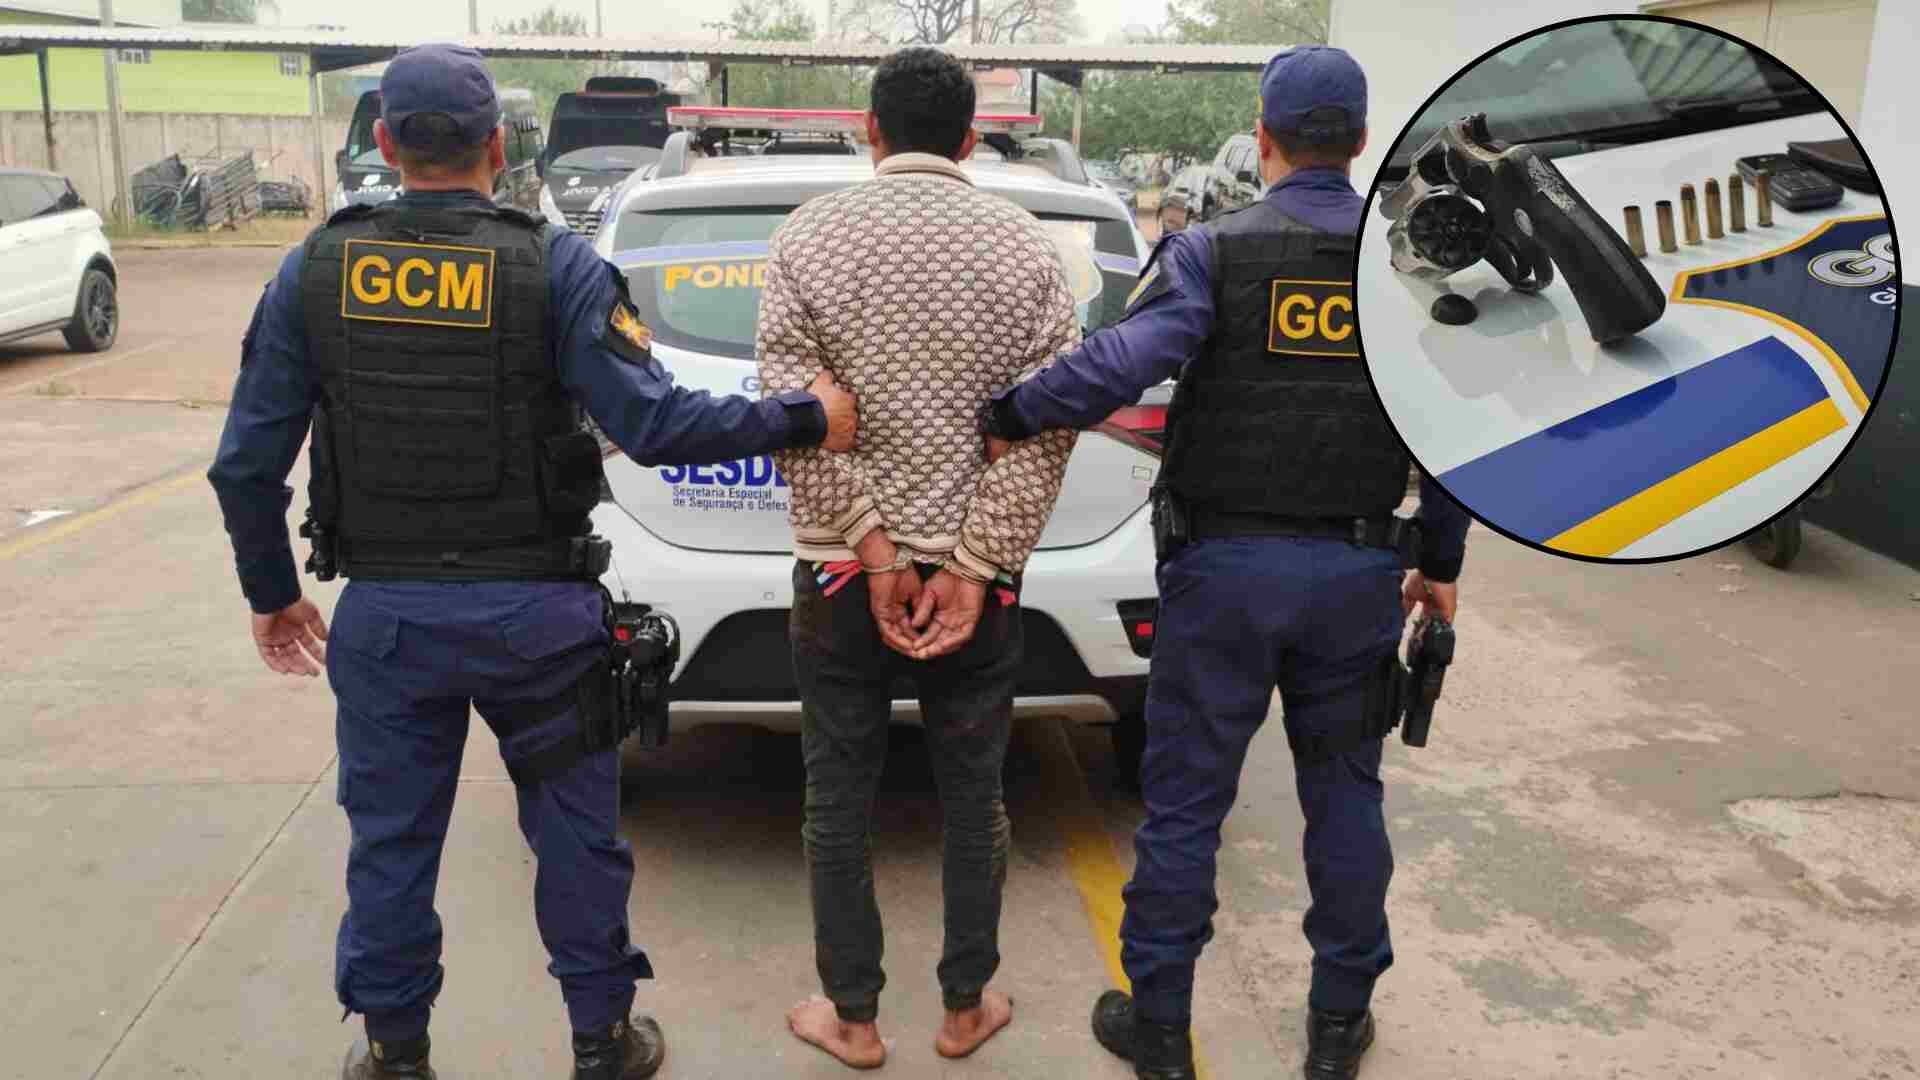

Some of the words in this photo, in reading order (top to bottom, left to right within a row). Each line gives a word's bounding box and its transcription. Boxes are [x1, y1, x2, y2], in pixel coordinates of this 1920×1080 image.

[350, 254, 485, 312] GCM
[1278, 293, 1354, 341] GC
[672, 485, 725, 499] Secretaria
[672, 497, 686, 508] de
[689, 497, 744, 511] Segurança
